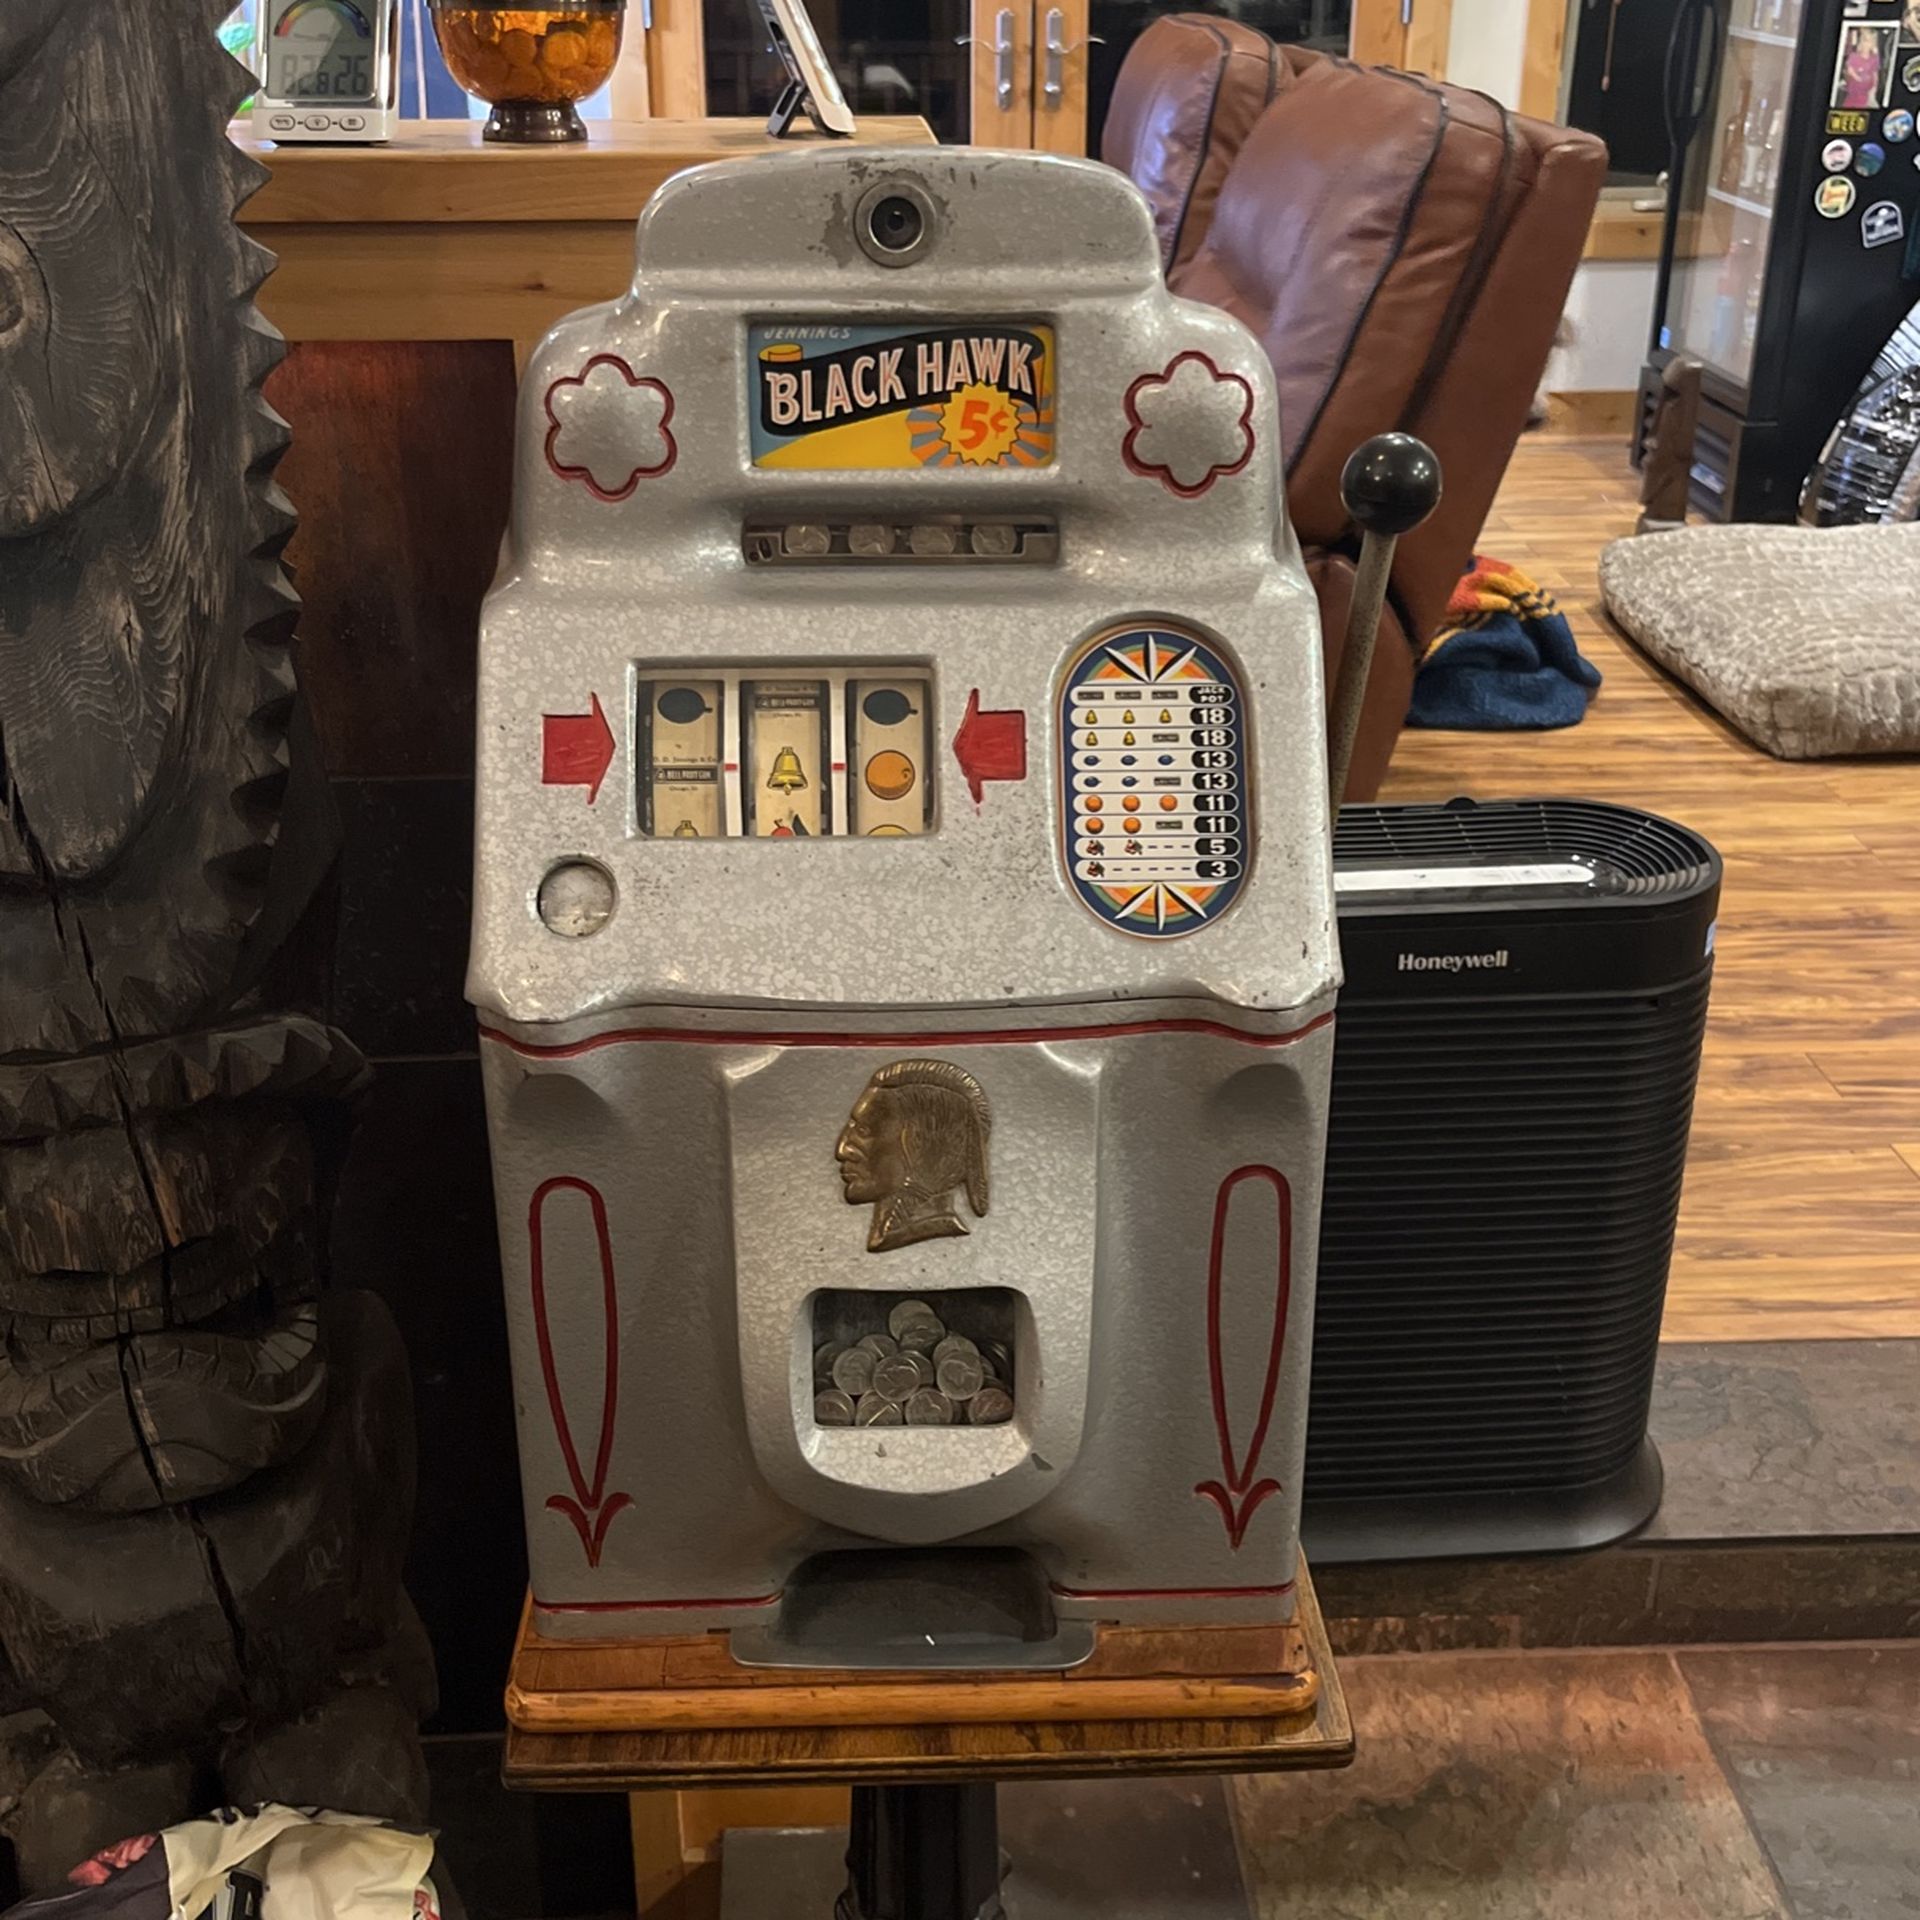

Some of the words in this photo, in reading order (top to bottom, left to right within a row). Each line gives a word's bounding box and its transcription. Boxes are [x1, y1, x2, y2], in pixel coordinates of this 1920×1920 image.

[764, 327, 852, 339] JENNINGS
[765, 348, 906, 425] BLACK
[917, 338, 1033, 395] HAWK
[958, 400, 1010, 450] 5¢
[1197, 686, 1225, 695] JACK
[1200, 695, 1224, 703] POT
[1199, 708, 1226, 724] 18
[1200, 729, 1227, 746] 18
[1201, 752, 1228, 768] 13
[1202, 773, 1228, 789] 13
[1206, 795, 1225, 811] 11
[1207, 817, 1226, 833] 11
[1210, 839, 1227, 855] 5
[1211, 861, 1227, 878] 3
[1398, 950, 1508, 973] Honeywell
